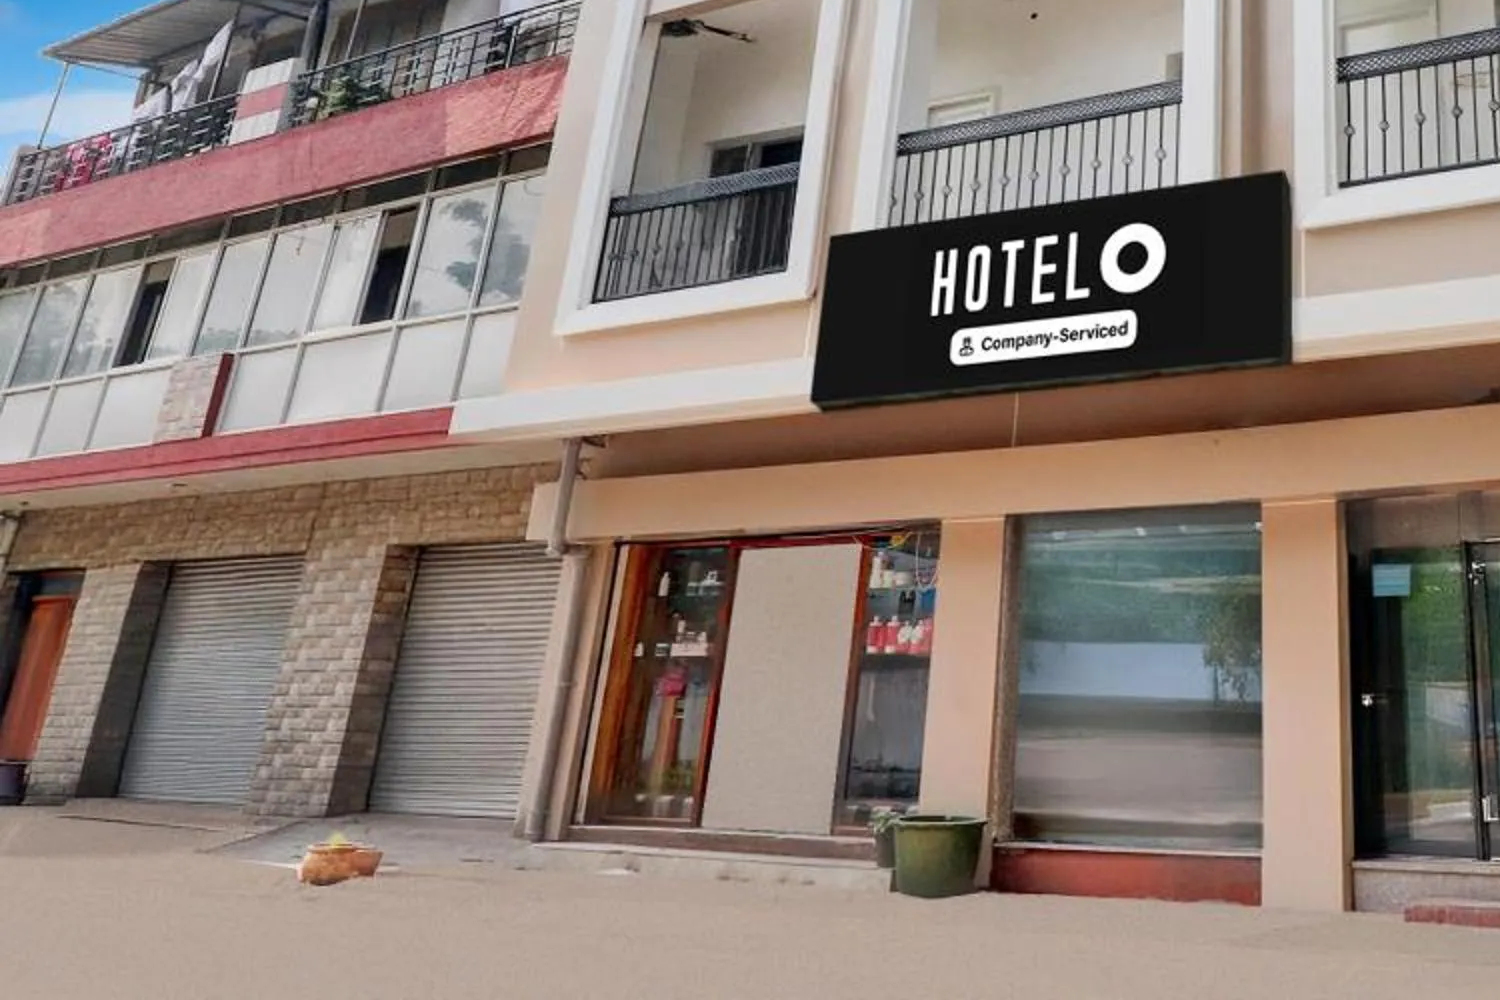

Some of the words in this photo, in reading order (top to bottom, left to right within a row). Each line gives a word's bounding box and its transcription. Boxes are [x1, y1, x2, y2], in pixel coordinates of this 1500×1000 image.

[930, 231, 1091, 317] HOTEL
[1100, 222, 1167, 294] O
[981, 320, 1129, 351] Company-Serviced
